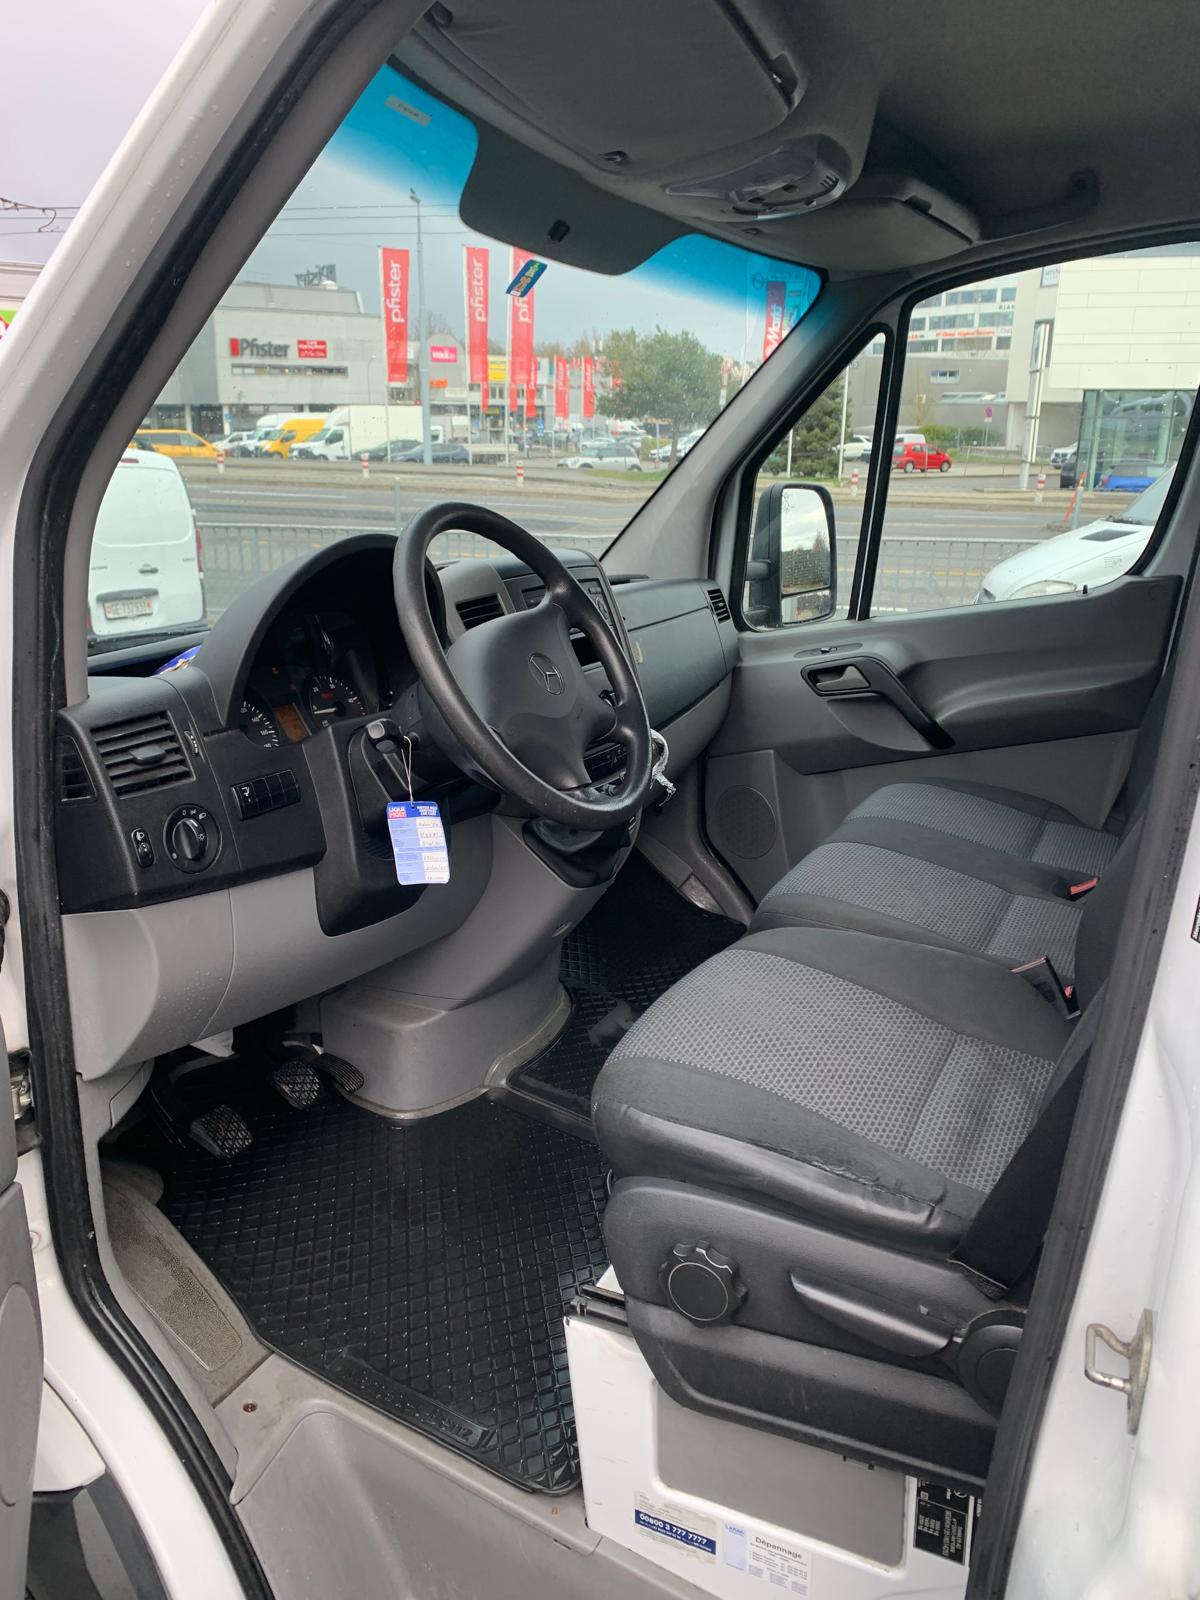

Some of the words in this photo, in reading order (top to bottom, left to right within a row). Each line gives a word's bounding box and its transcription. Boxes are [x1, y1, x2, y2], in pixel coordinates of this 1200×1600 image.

[386, 260, 405, 323] pfister
[471, 258, 487, 322] pfister
[240, 338, 290, 357] Pfister
[639, 1513, 664, 1528] 00800
[672, 1526, 687, 1537] 777
[688, 1532, 708, 1545] 7777
[755, 1536, 803, 1560] Dépannage
